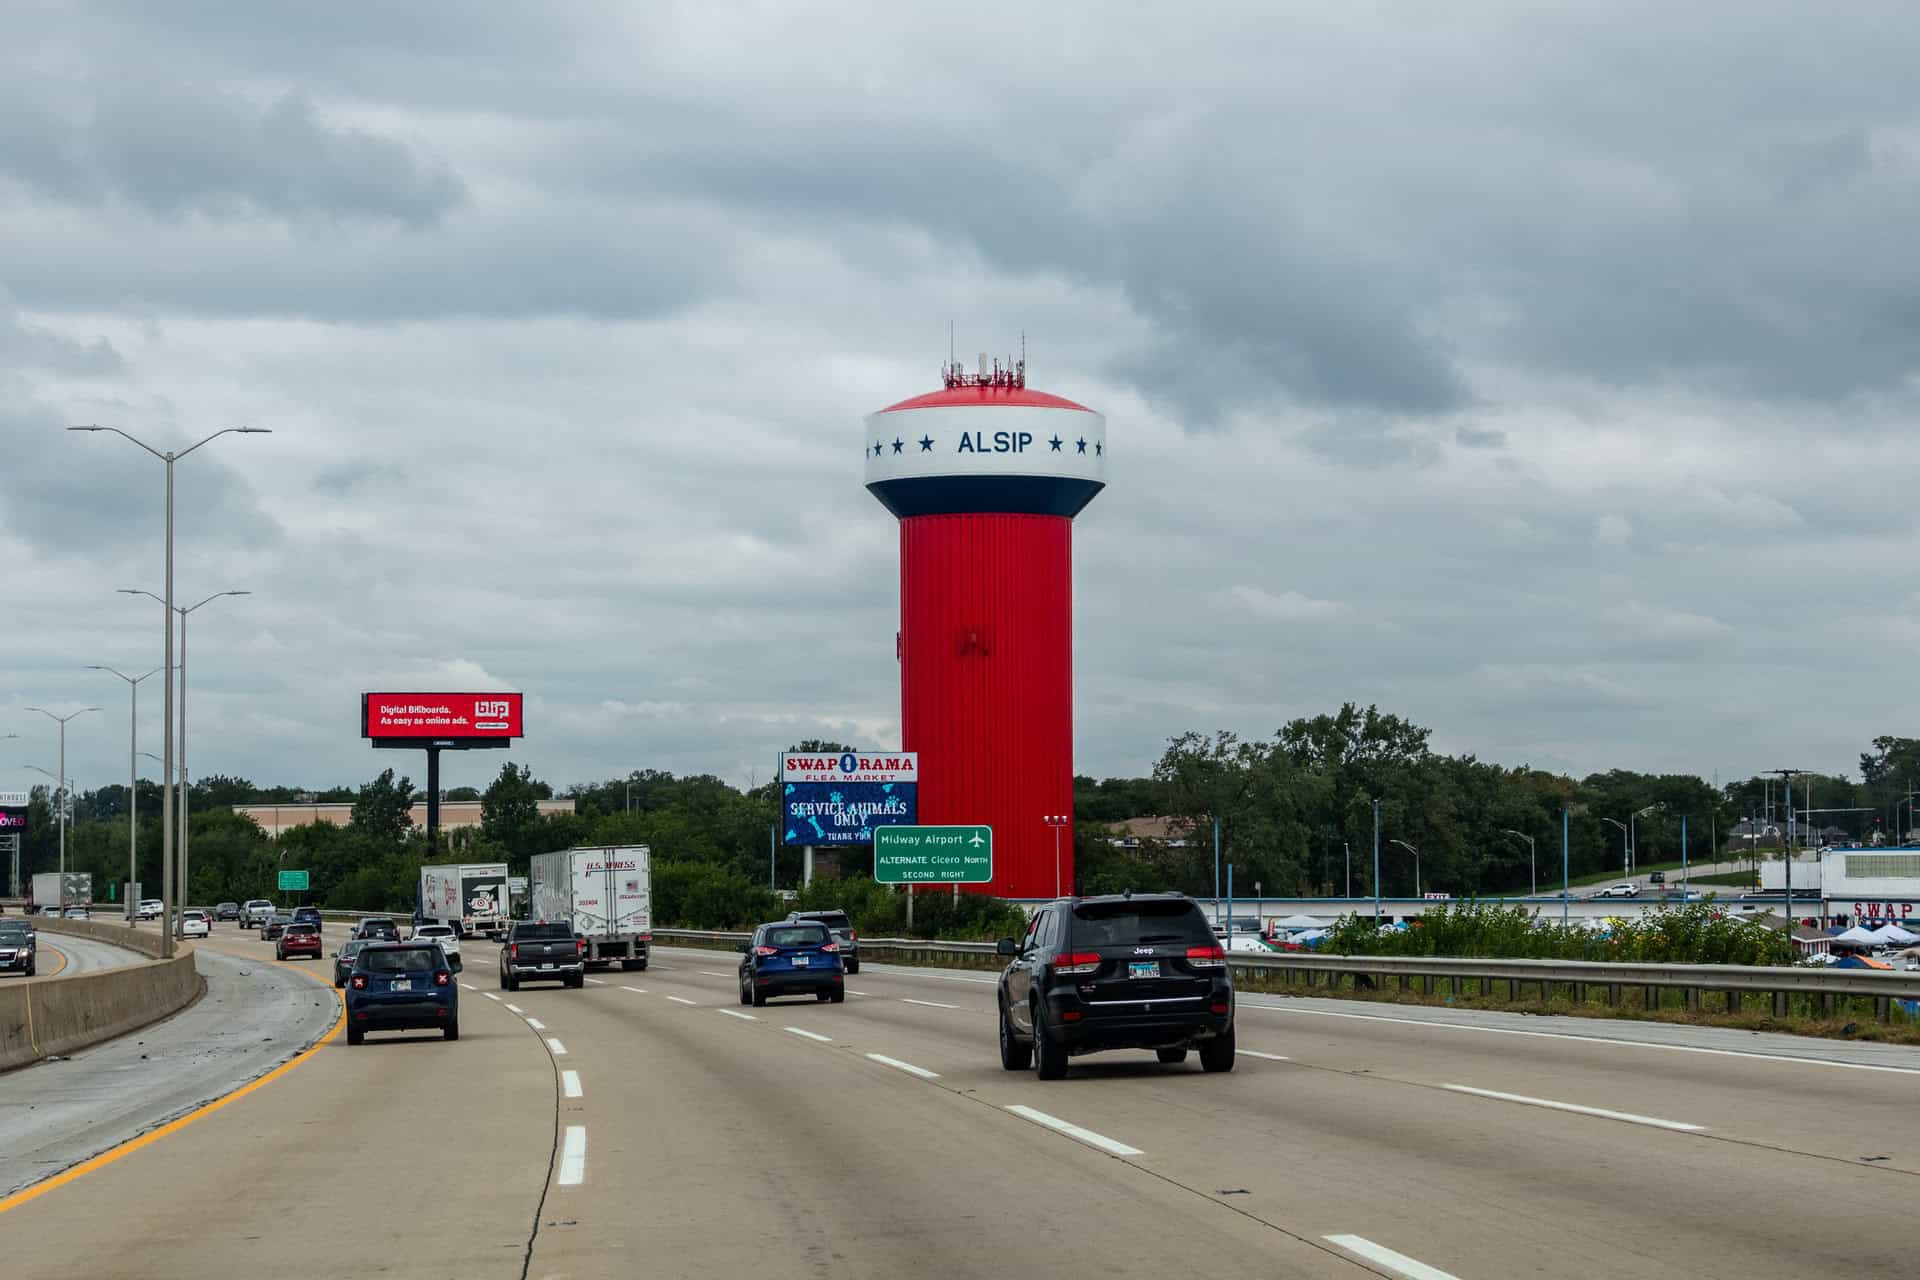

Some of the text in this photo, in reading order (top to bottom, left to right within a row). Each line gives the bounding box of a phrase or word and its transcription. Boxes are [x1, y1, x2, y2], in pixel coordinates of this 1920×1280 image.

[958, 431, 1033, 453] ALSIP
[380, 705, 452, 716] Digital Billboards.
[475, 701, 510, 719] blip
[380, 716, 470, 727] As easy as online ads.
[787, 758, 839, 771] SWAP
[859, 758, 914, 771] RAMA
[790, 802, 907, 816] SERVICE ANIMALS
[833, 812, 867, 827] ONLY
[827, 832, 853, 841] THANK
[881, 834, 963, 847] Midway Airport
[880, 856, 929, 865] ALTERNATE
[930, 856, 960, 865] Cicero
[902, 871, 965, 879] SECOND RIGHT
[1854, 902, 1913, 920] SWAP
[1133, 947, 1154, 955] Jeep
